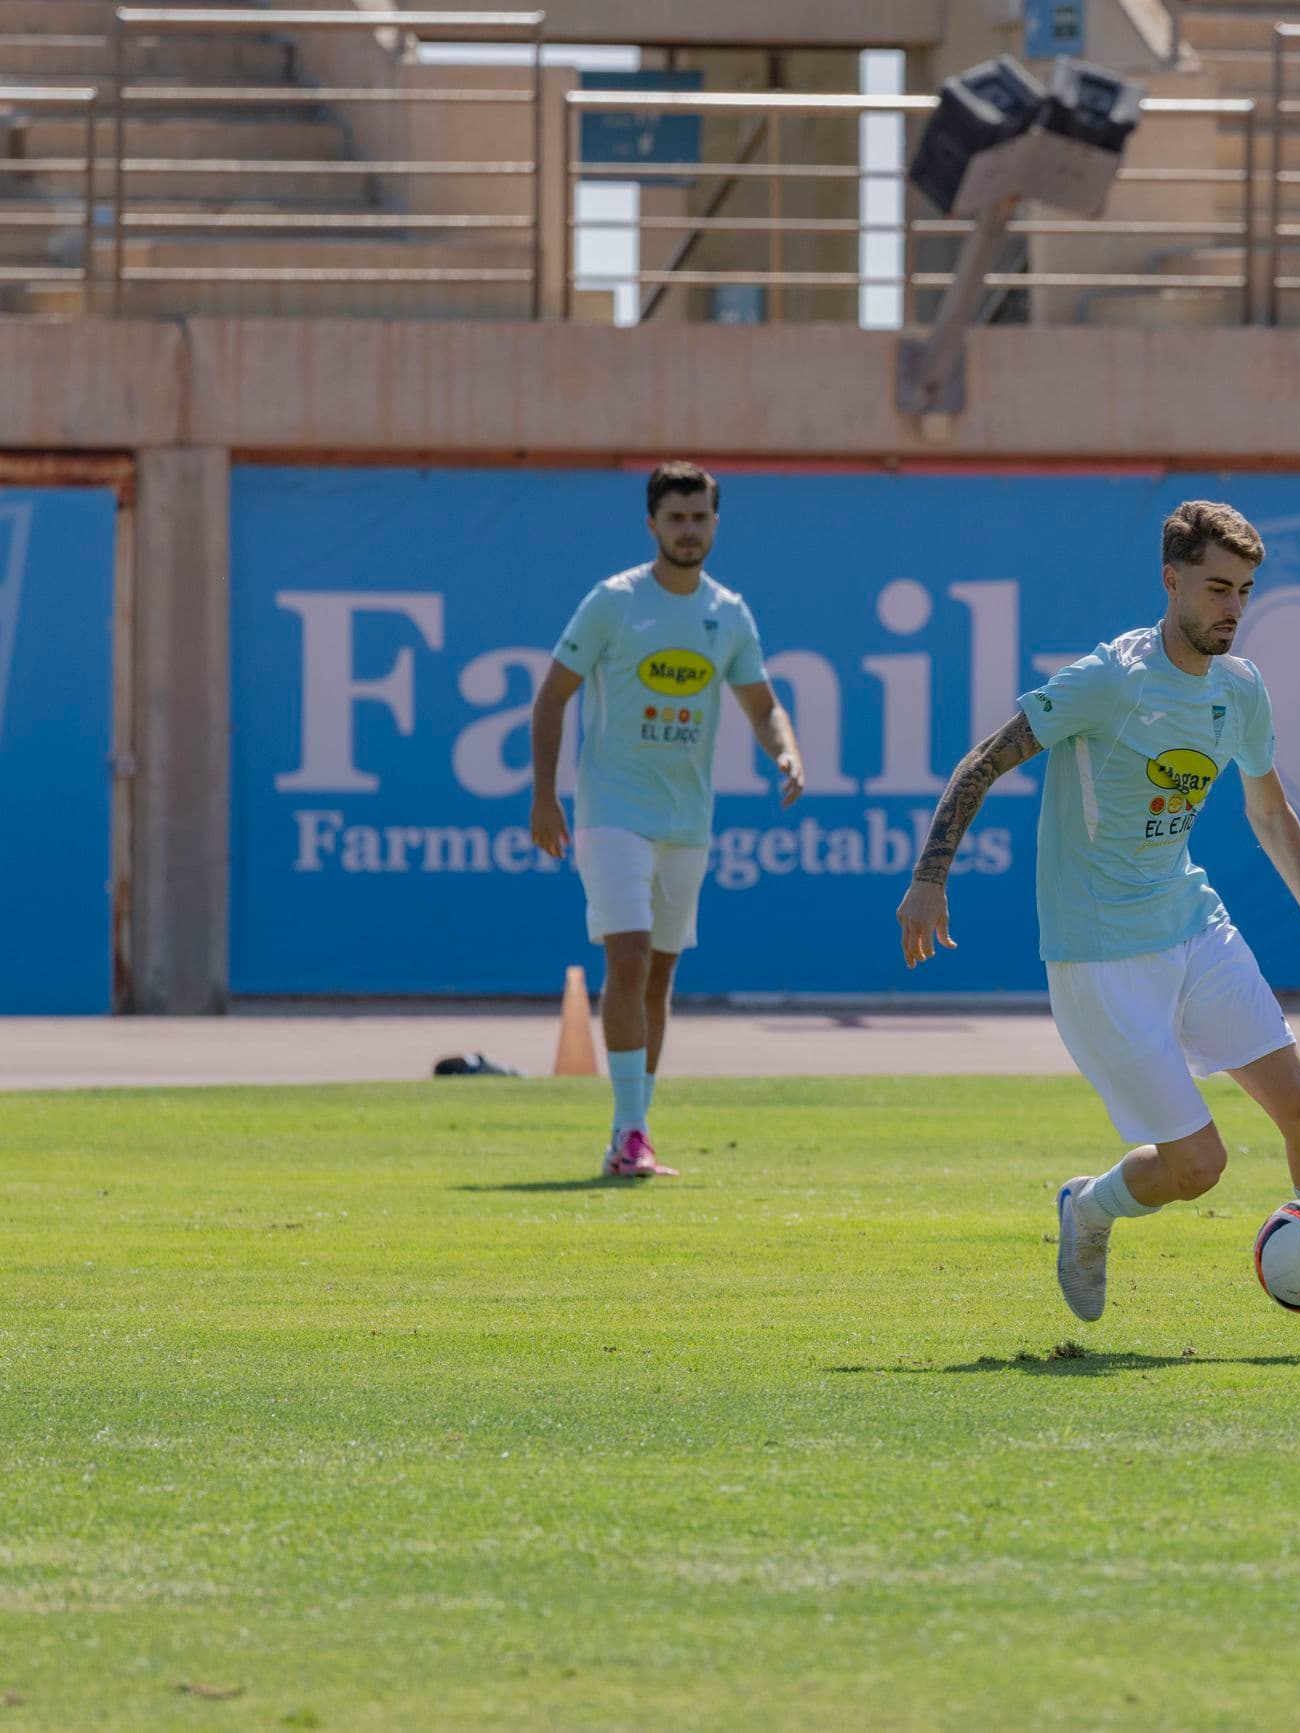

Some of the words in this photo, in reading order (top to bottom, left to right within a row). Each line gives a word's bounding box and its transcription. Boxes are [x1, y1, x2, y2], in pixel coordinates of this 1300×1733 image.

[649, 660, 708, 685] Magar
[275, 579, 1088, 797] Famil
[641, 723, 657, 741] EL
[1145, 819, 1164, 838] EL
[294, 810, 578, 874] Farme
